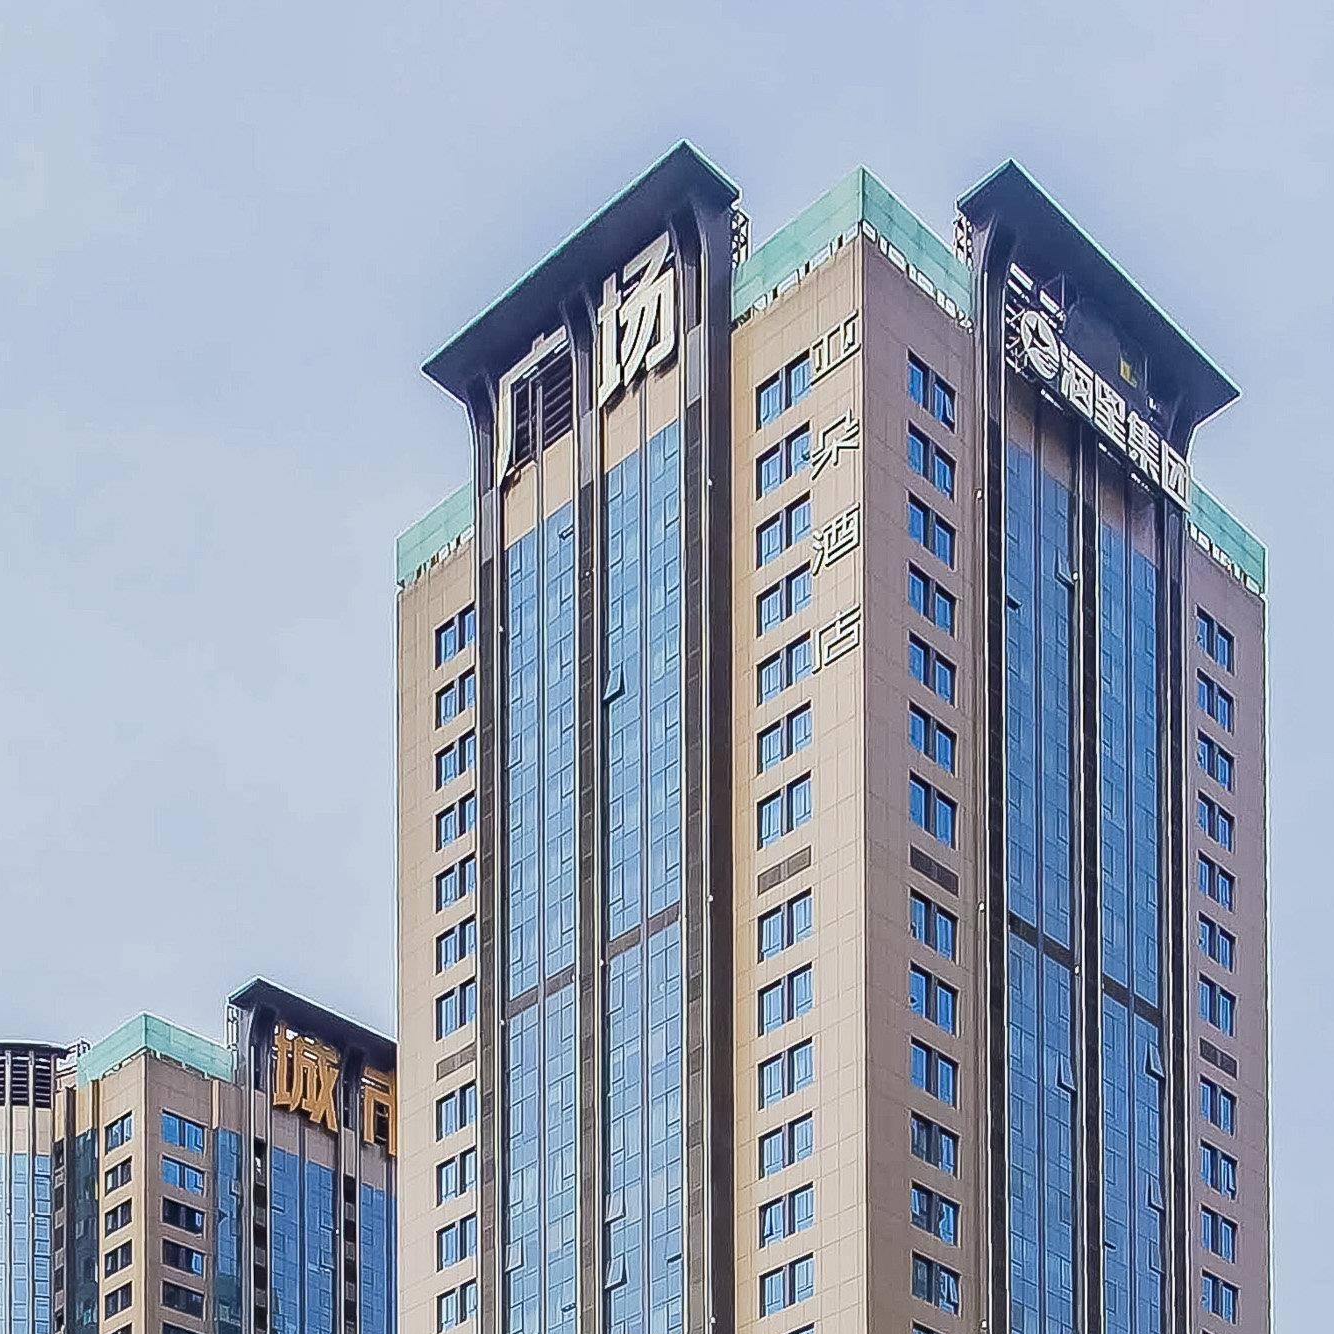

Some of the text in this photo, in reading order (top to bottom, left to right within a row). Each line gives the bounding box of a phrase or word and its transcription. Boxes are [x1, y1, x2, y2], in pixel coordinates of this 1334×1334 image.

[495, 231, 675, 488] 广场
[810, 308, 862, 676] 亚朵酒店
